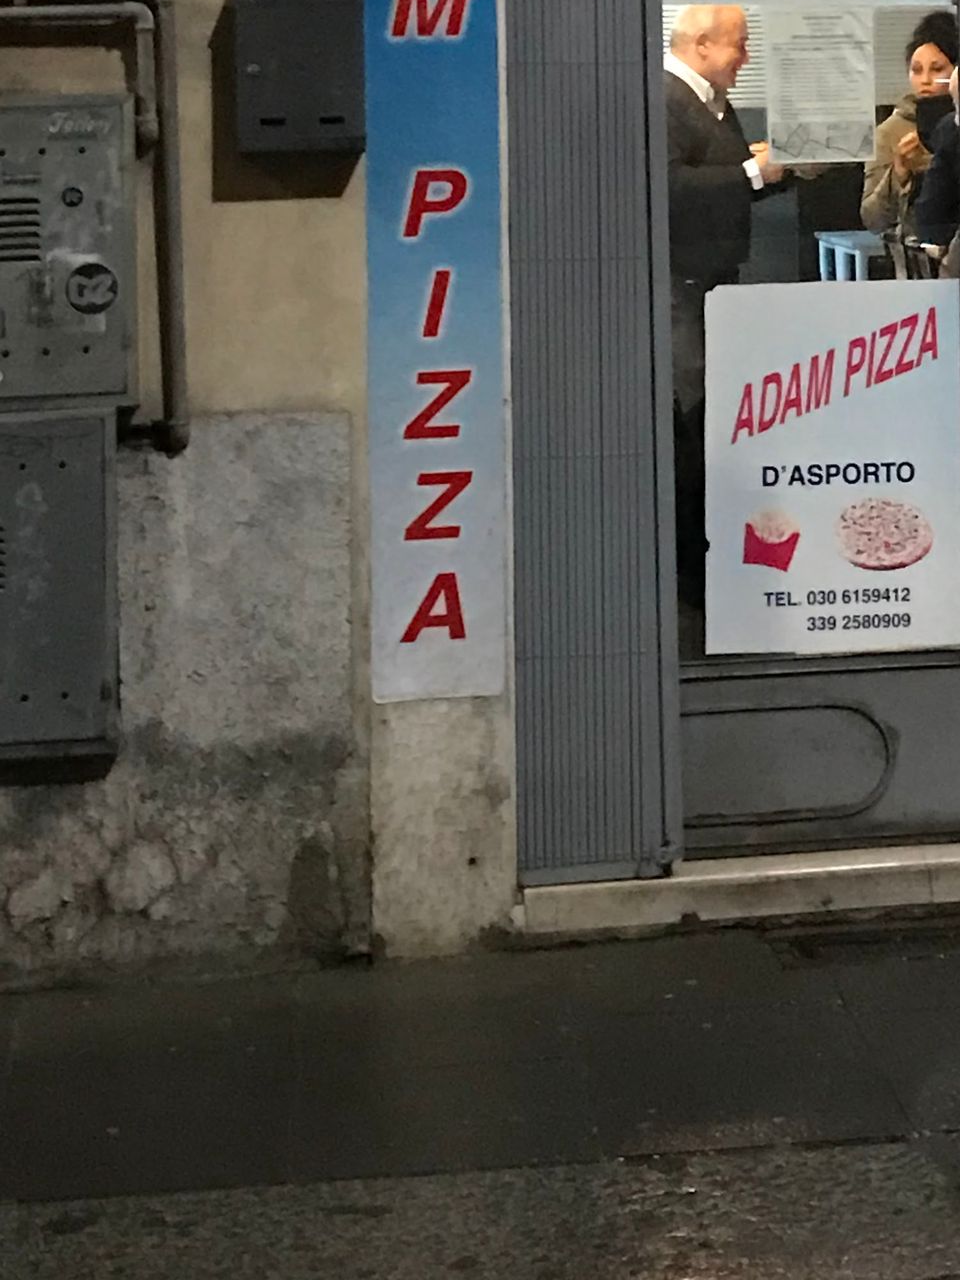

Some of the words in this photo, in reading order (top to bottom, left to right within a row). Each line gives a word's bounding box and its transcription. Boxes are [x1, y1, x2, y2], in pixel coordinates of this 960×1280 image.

[731, 348, 836, 445] ADAM
[843, 306, 939, 398] PIZZA
[400, 169, 474, 643] PIZZA
[761, 462, 916, 487] D'ASPORTO
[764, 592, 802, 607] TEL.
[806, 590, 837, 605] 030
[841, 587, 911, 603] 6159412
[806, 617, 837, 631] 339
[842, 613, 912, 630] 2580909
